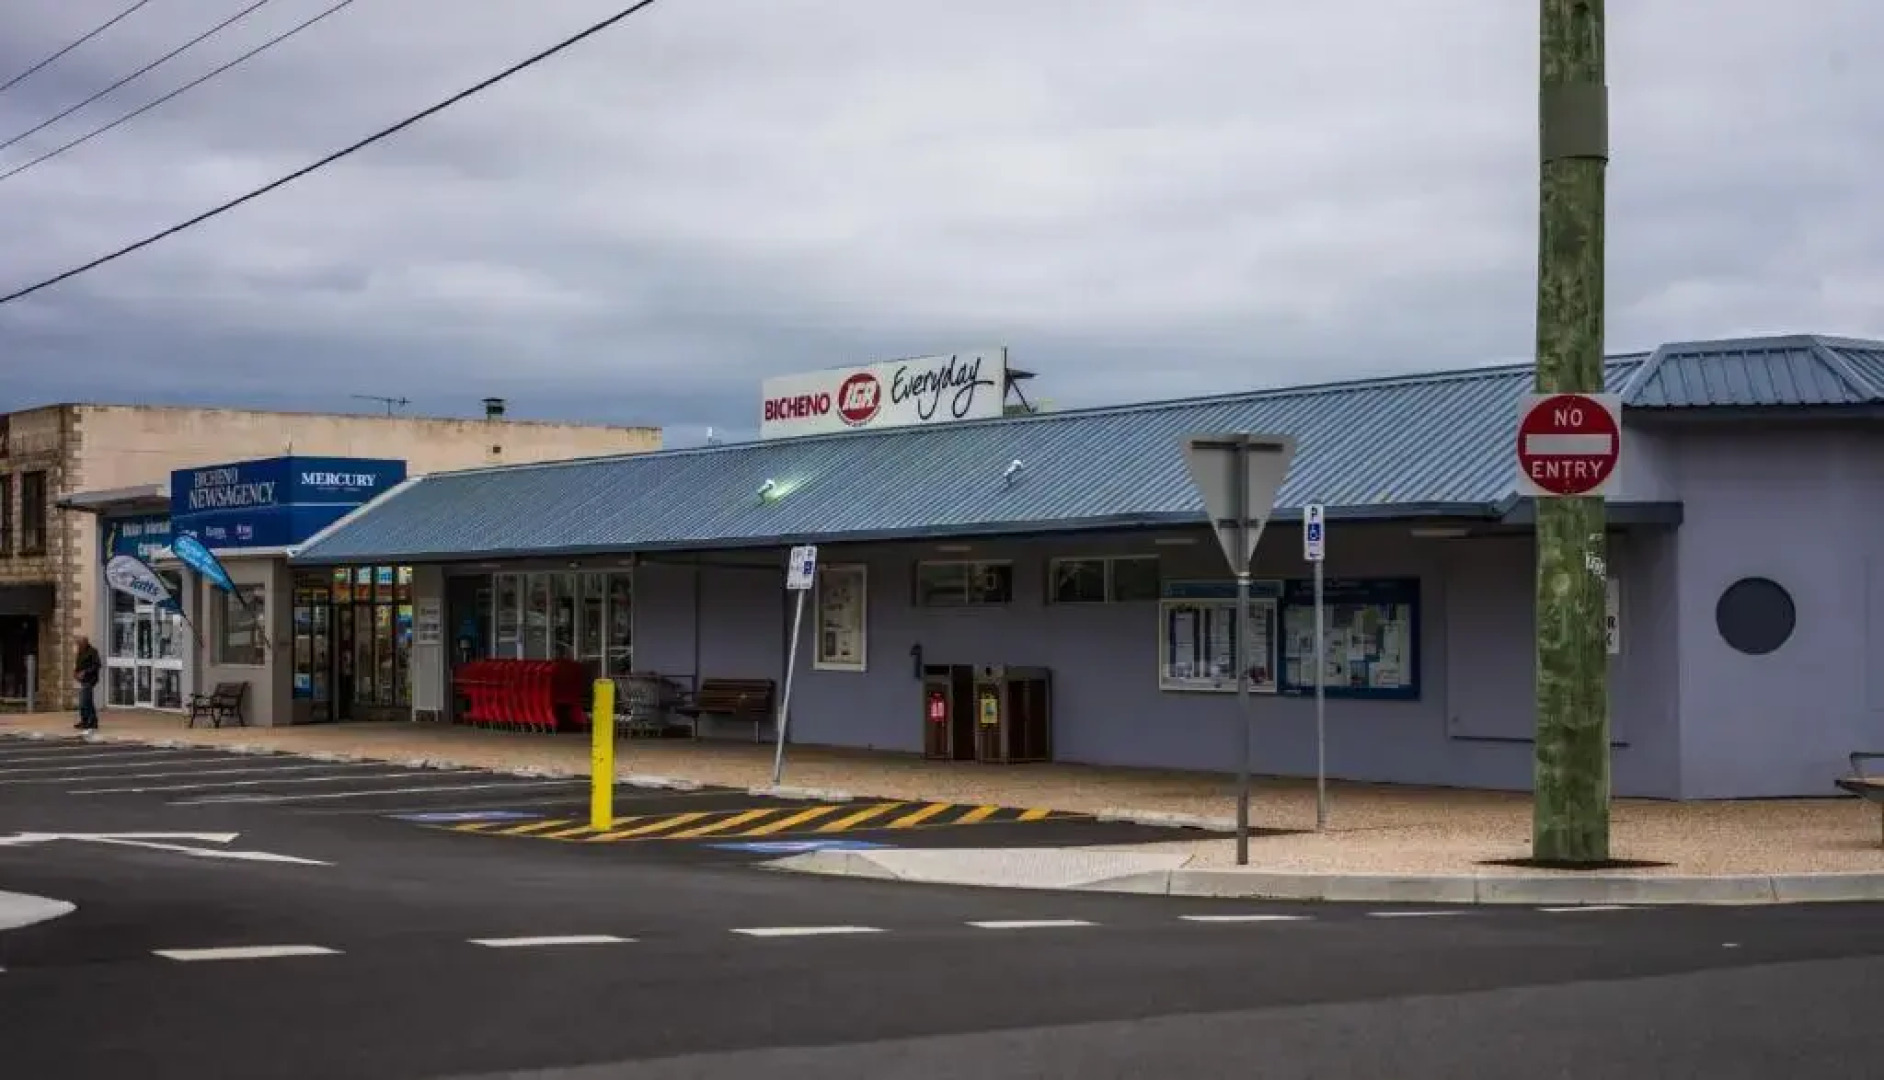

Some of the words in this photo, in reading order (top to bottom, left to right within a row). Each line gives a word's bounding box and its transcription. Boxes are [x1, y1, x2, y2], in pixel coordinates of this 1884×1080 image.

[764, 393, 831, 421] BICHENO
[844, 381, 877, 411] IGA
[891, 355, 994, 419] Everyday
[1553, 408, 1584, 427] NO
[194, 467, 238, 488] BICHENO
[1531, 460, 1605, 479] ENTRY
[301, 472, 377, 487] MERCURY
[189, 482, 275, 509] NEWSAGENCY
[1311, 506, 1318, 521] P
